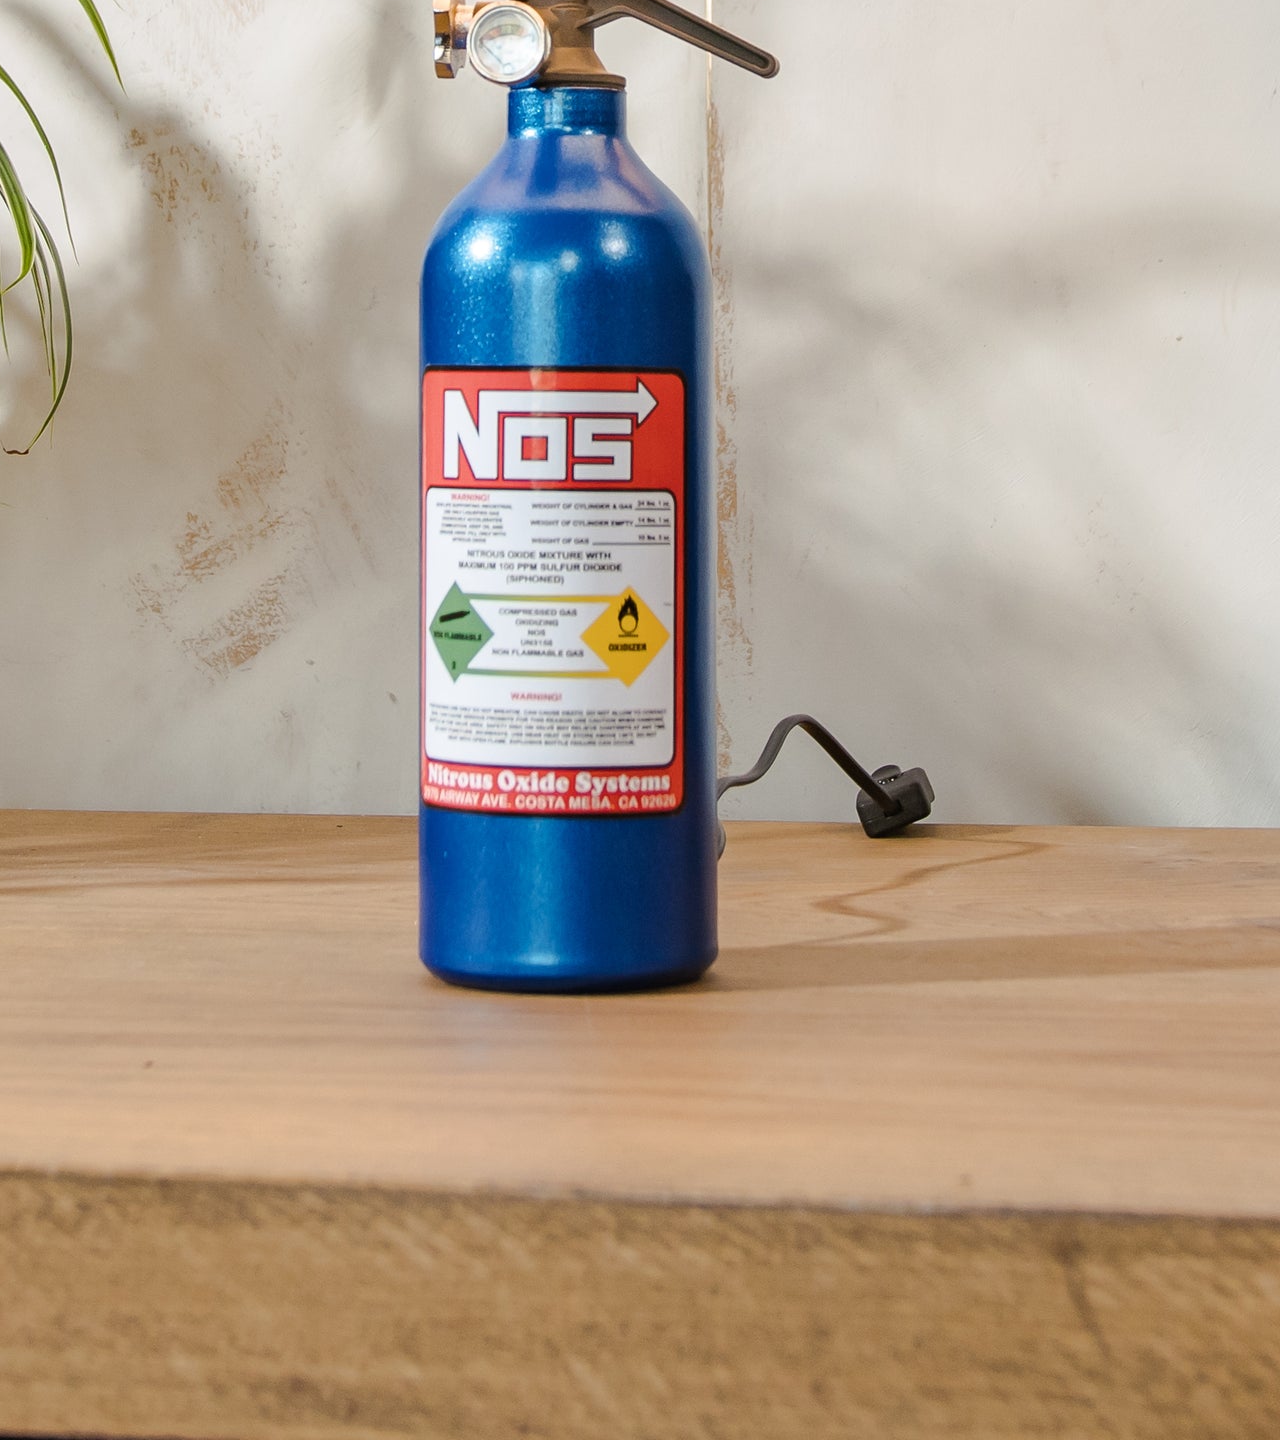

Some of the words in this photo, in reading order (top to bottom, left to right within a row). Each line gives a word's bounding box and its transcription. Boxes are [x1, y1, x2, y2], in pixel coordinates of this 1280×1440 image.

[443, 389, 634, 481] NOS
[467, 550, 505, 559] NITROUS
[507, 550, 536, 559] OXIDE
[539, 551, 583, 559] MIXTURE
[586, 551, 611, 560] WITH
[458, 561, 496, 569] MAXIMUM
[500, 562, 514, 570] 100
[517, 563, 537, 571] PPM
[540, 563, 580, 571] SULFUR
[583, 563, 622, 571] DIOXIDE
[506, 575, 565, 584] (SIPHONED)
[499, 608, 557, 616] COMPRESSED
[608, 643, 647, 652] OXIDIZER
[512, 649, 564, 657] FLAMMABLE
[511, 692, 562, 701] WARNING!
[428, 762, 493, 791] Nitrous
[497, 769, 569, 793] Oxide
[575, 771, 670, 796] Systems
[440, 788, 480, 806] AIRWAY
[515, 795, 565, 810] COSTA
[619, 795, 638, 810] CA
